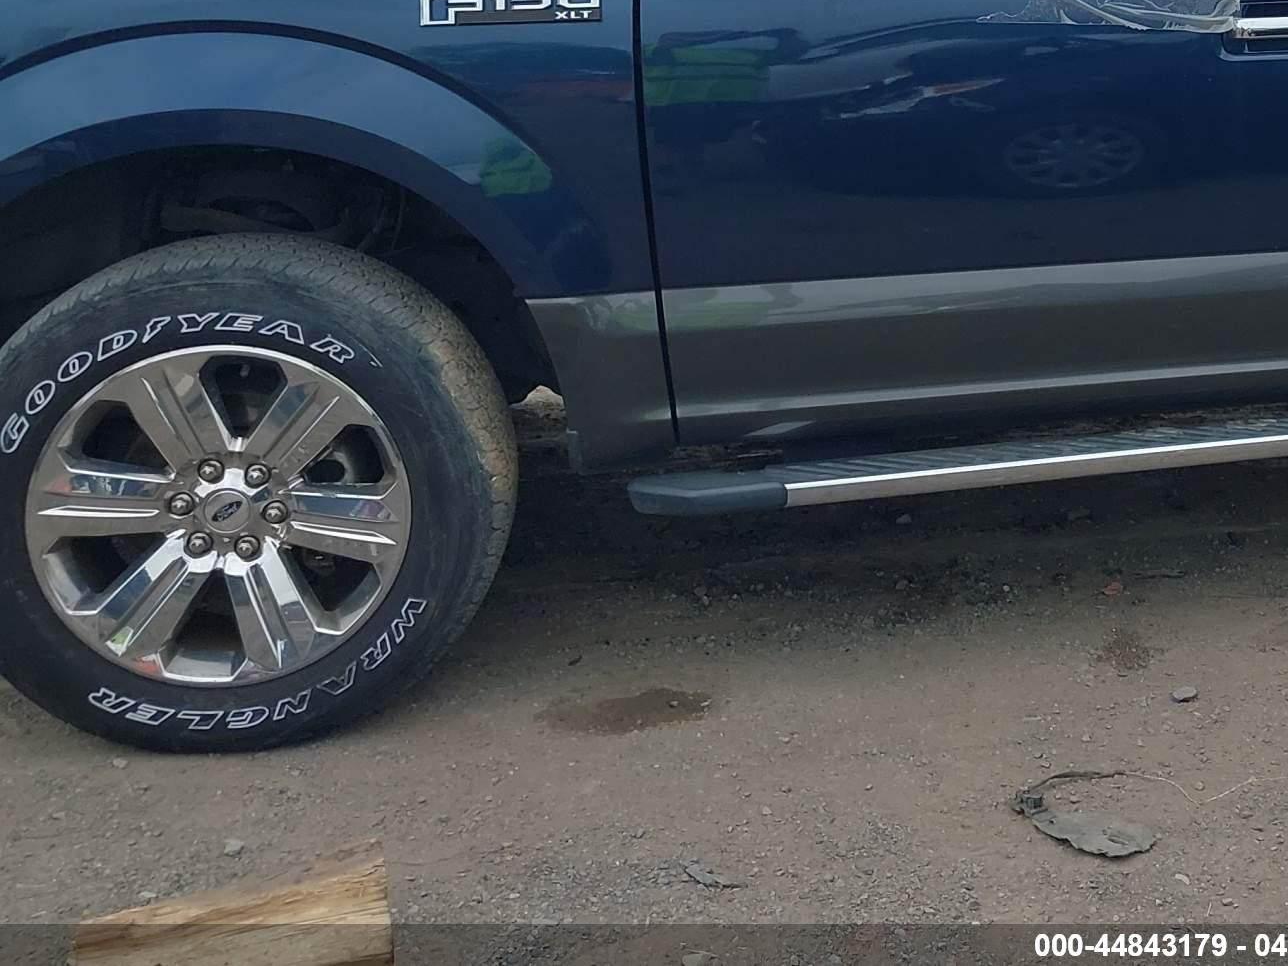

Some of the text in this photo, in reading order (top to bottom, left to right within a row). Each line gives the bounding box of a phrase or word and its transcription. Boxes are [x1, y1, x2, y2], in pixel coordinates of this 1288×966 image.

[555, 10, 593, 20] XLT
[0, 312, 355, 454] GOODYEAR
[88, 598, 429, 731] WRANGLER
